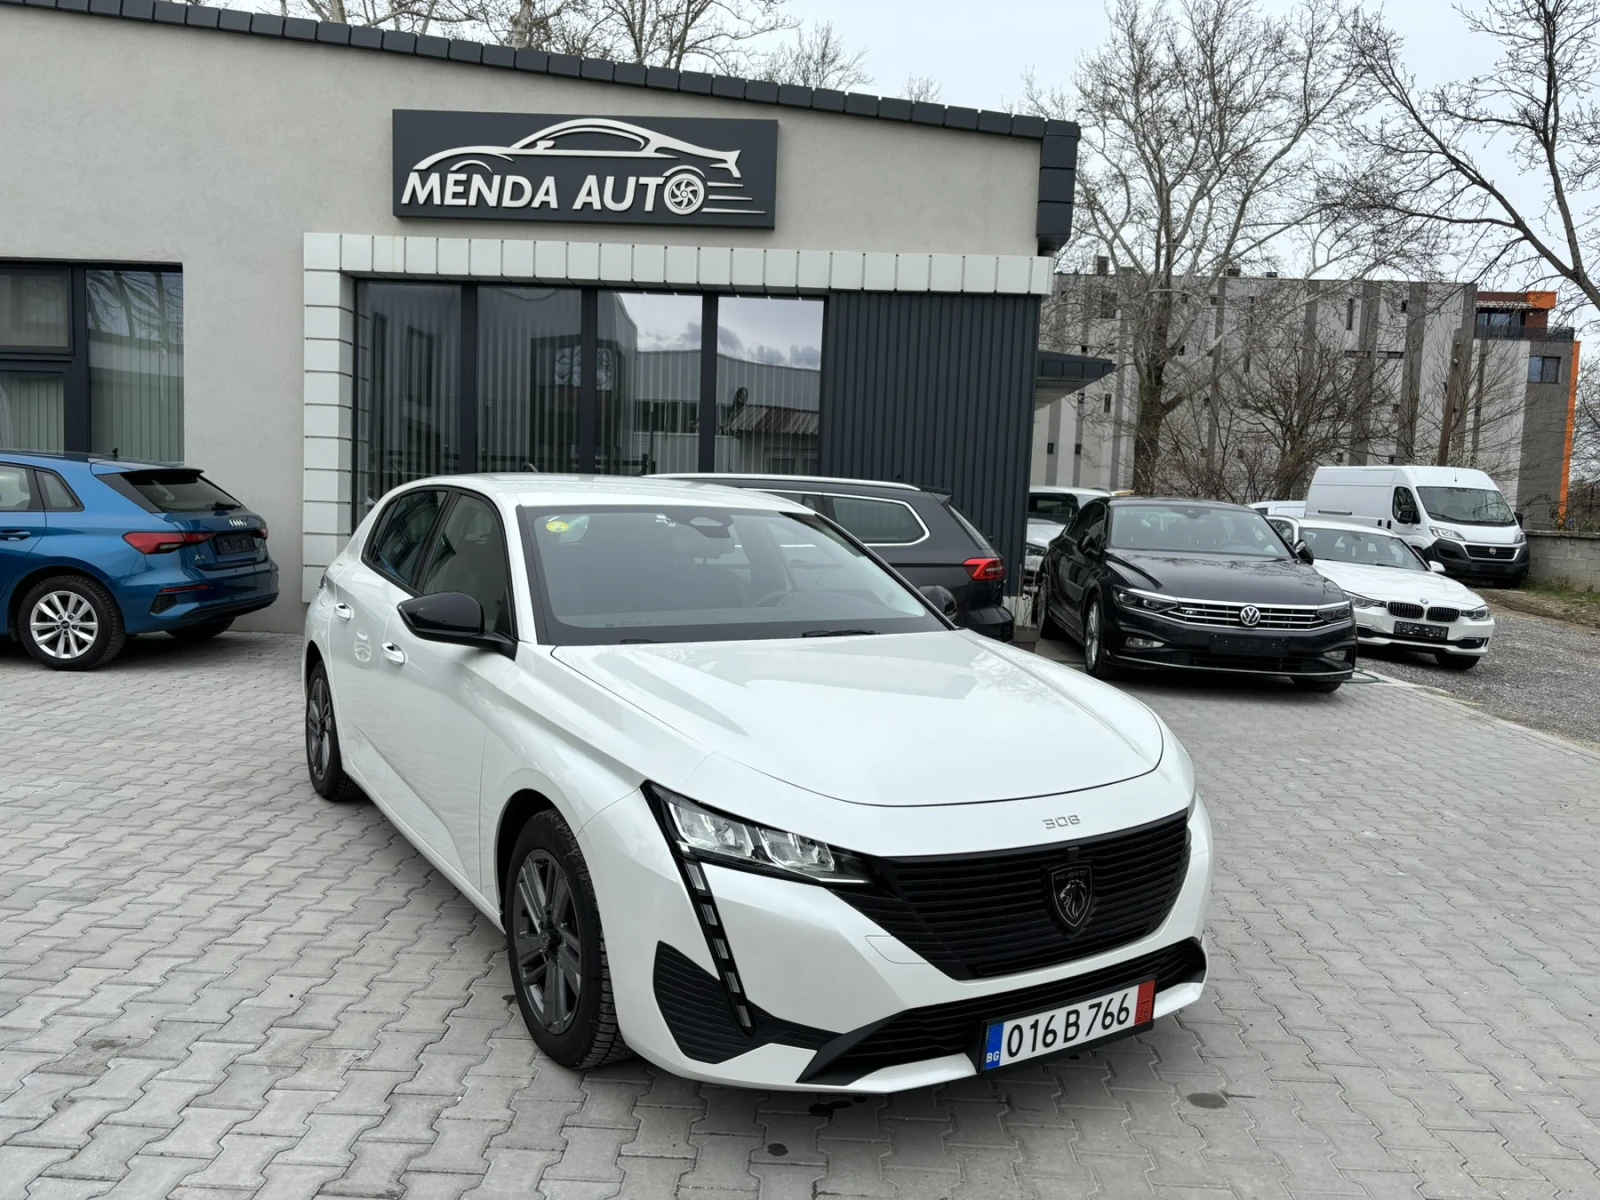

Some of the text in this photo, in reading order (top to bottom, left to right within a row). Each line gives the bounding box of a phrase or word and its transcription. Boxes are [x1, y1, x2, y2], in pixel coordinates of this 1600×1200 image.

[401, 172, 705, 215] MENDA AUTO
[1042, 814, 1081, 829] 308
[986, 1050, 1000, 1063] BG
